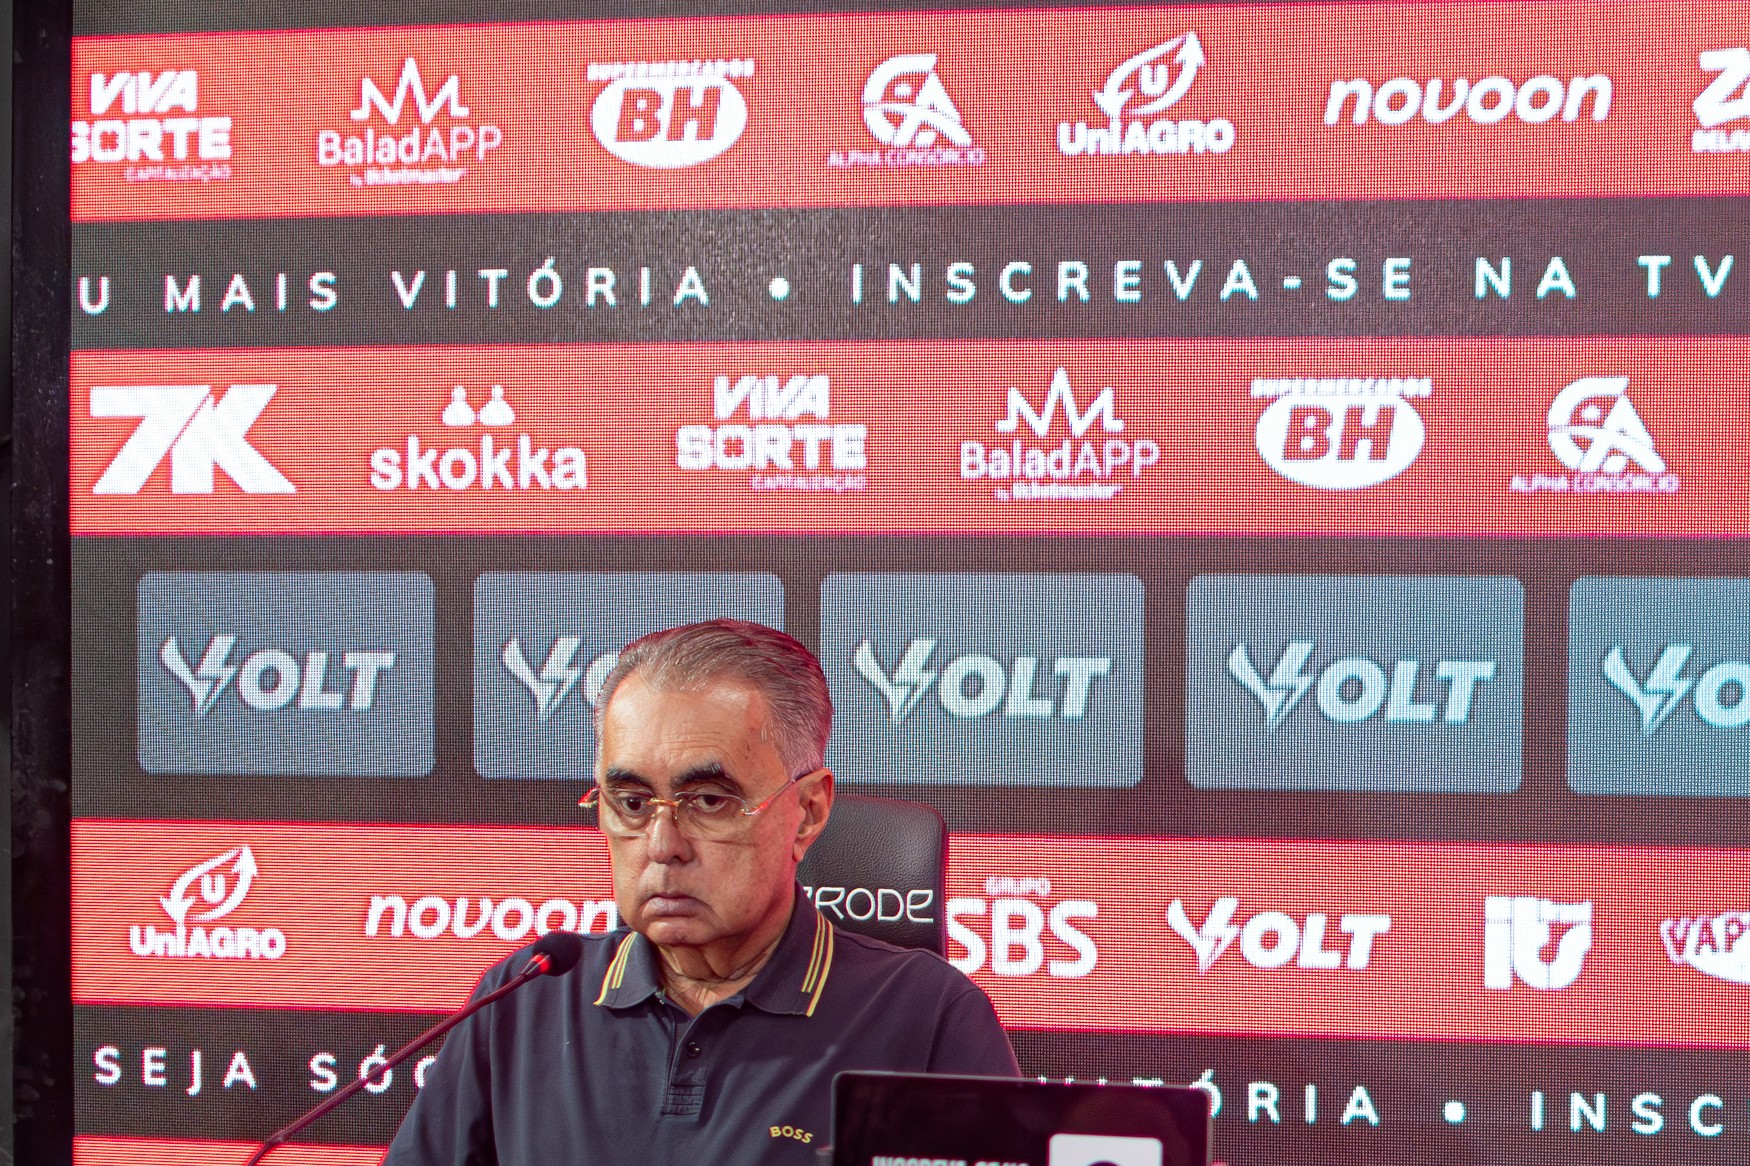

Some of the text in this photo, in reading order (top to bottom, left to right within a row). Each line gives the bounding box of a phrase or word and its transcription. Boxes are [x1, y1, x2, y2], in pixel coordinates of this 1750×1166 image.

[91, 70, 197, 115] VIVA
[614, 84, 724, 144] BH
[1323, 73, 1613, 126] novoon
[71, 116, 232, 163] SORTE
[317, 127, 502, 167] BaladAPP
[164, 271, 339, 313] MAIS
[391, 255, 711, 310] VITÓRIA
[851, 256, 1412, 305] INSCREVA-SE
[1474, 255, 1577, 300] NA
[1637, 253, 1734, 298] TV
[713, 374, 831, 420] VIVA
[89, 383, 298, 495] 7K
[675, 423, 867, 471] SORTE
[1282, 403, 1398, 462] BH
[369, 434, 589, 491] skokka
[959, 439, 1161, 481] BaladAPP
[159, 634, 397, 716] VOLT
[853, 636, 1116, 726] VOLT
[1228, 642, 1497, 731] VOLT
[364, 894, 618, 939] novoon
[803, 886, 934, 924] RODE
[946, 898, 1099, 978] SBS
[1167, 897, 1392, 975] VOLT
[94, 1045, 257, 1096] SEJA
[769, 1124, 815, 1146] BOSS
